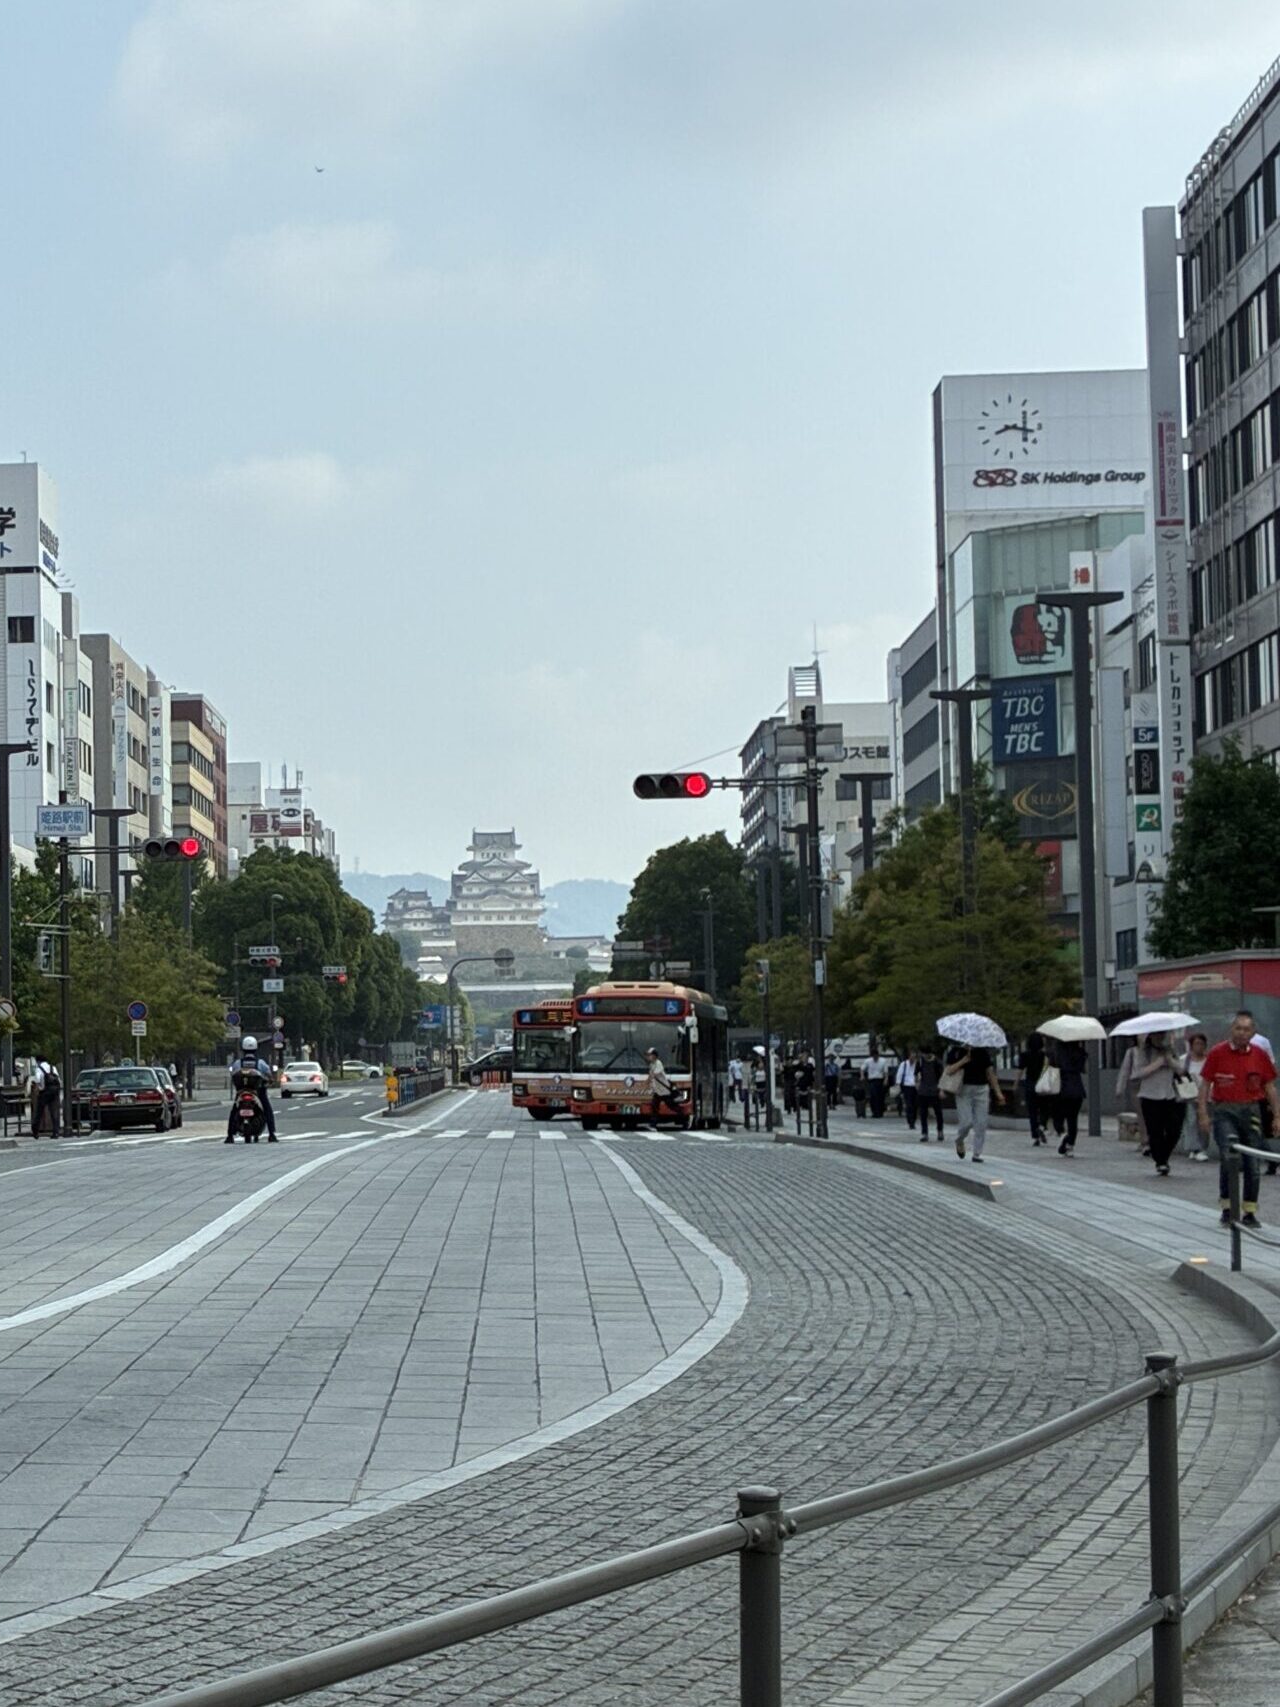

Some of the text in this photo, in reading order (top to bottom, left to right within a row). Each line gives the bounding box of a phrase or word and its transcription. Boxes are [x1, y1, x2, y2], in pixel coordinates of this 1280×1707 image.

[1020, 472, 1040, 486] SK
[1043, 470, 1102, 486] Holdings
[1104, 470, 1145, 484] Group
[1002, 695, 1045, 719] TBC
[1010, 721, 1039, 734] MEN'S
[1004, 731, 1044, 754] TBC
[41, 811, 84, 825] 姫路駅前
